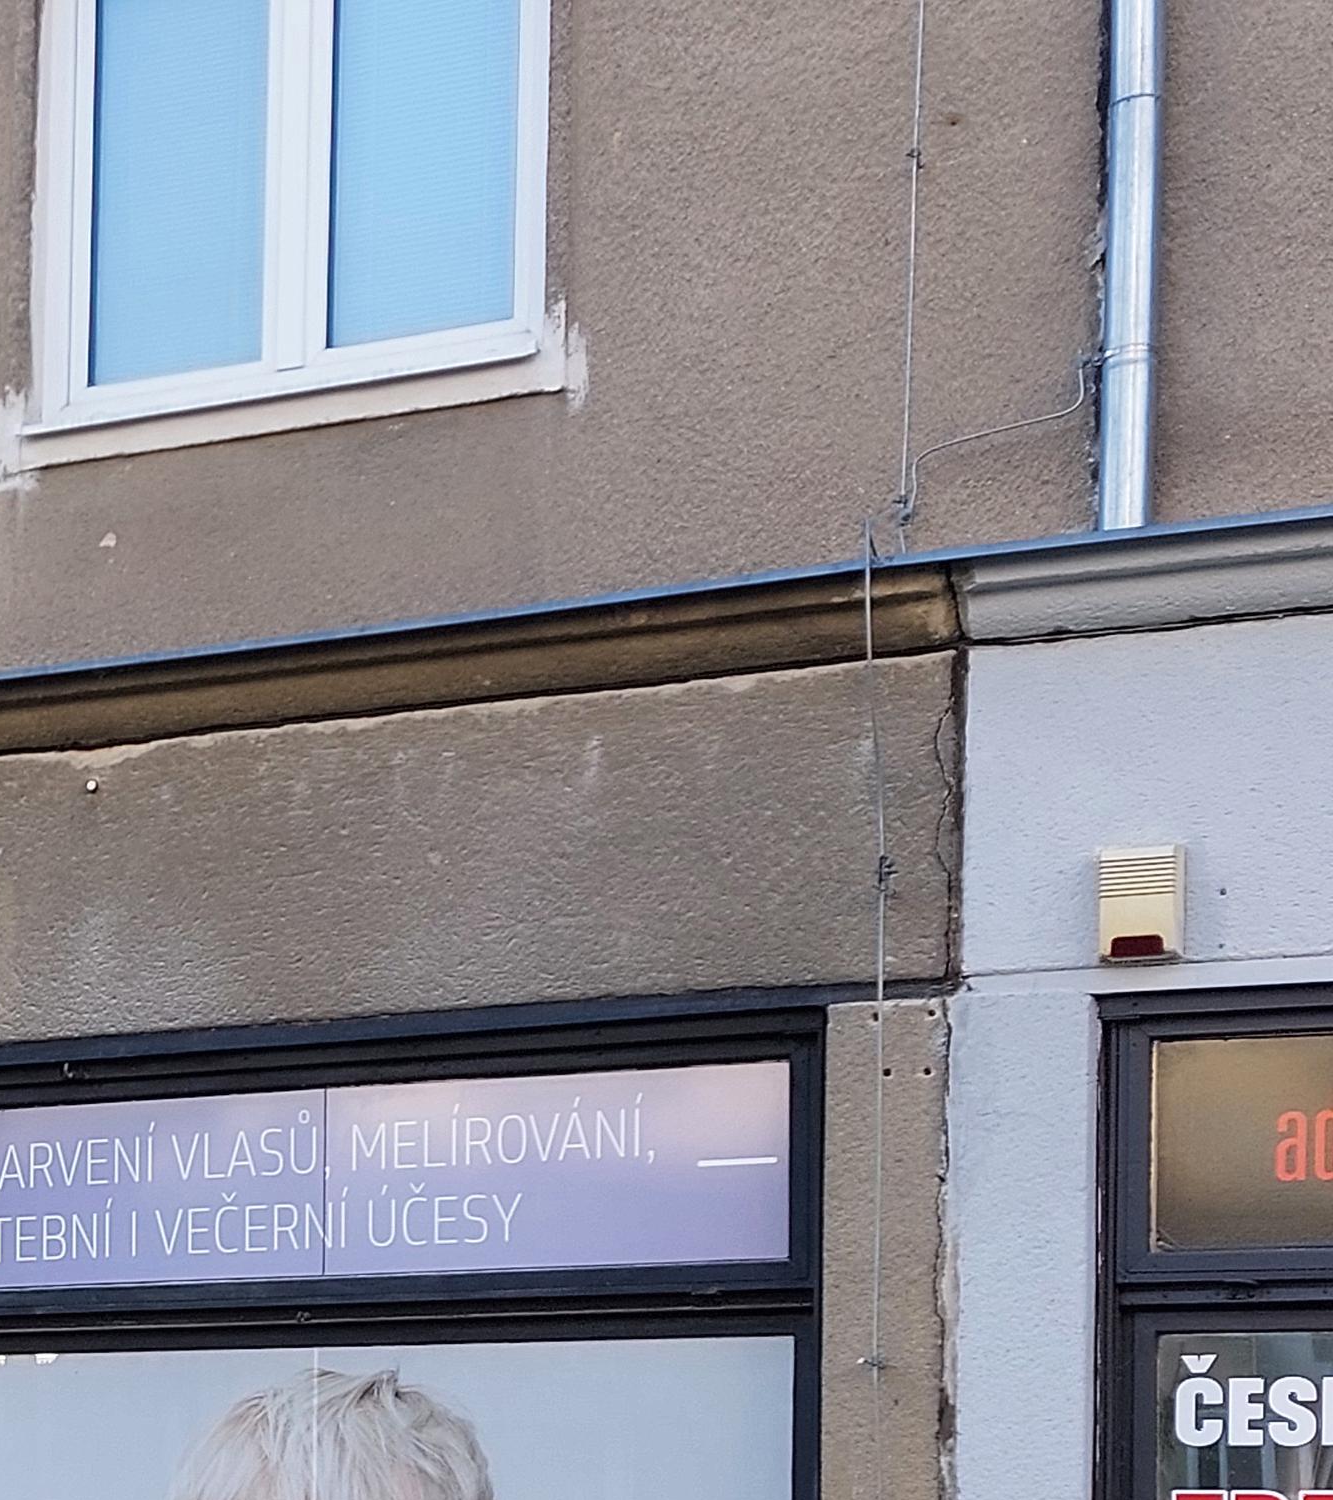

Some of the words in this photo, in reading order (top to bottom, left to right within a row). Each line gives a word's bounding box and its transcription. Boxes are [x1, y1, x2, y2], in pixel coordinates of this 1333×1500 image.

[170, 1109, 332, 1181] VLASŮ,
[350, 1094, 657, 1172] MELÍROVÁNÍ,
[131, 1209, 138, 1258] I
[154, 1191, 350, 1257] VEČERNÍ
[367, 1182, 524, 1248] ÚČESY
[1173, 1353, 1333, 1447] ČES
